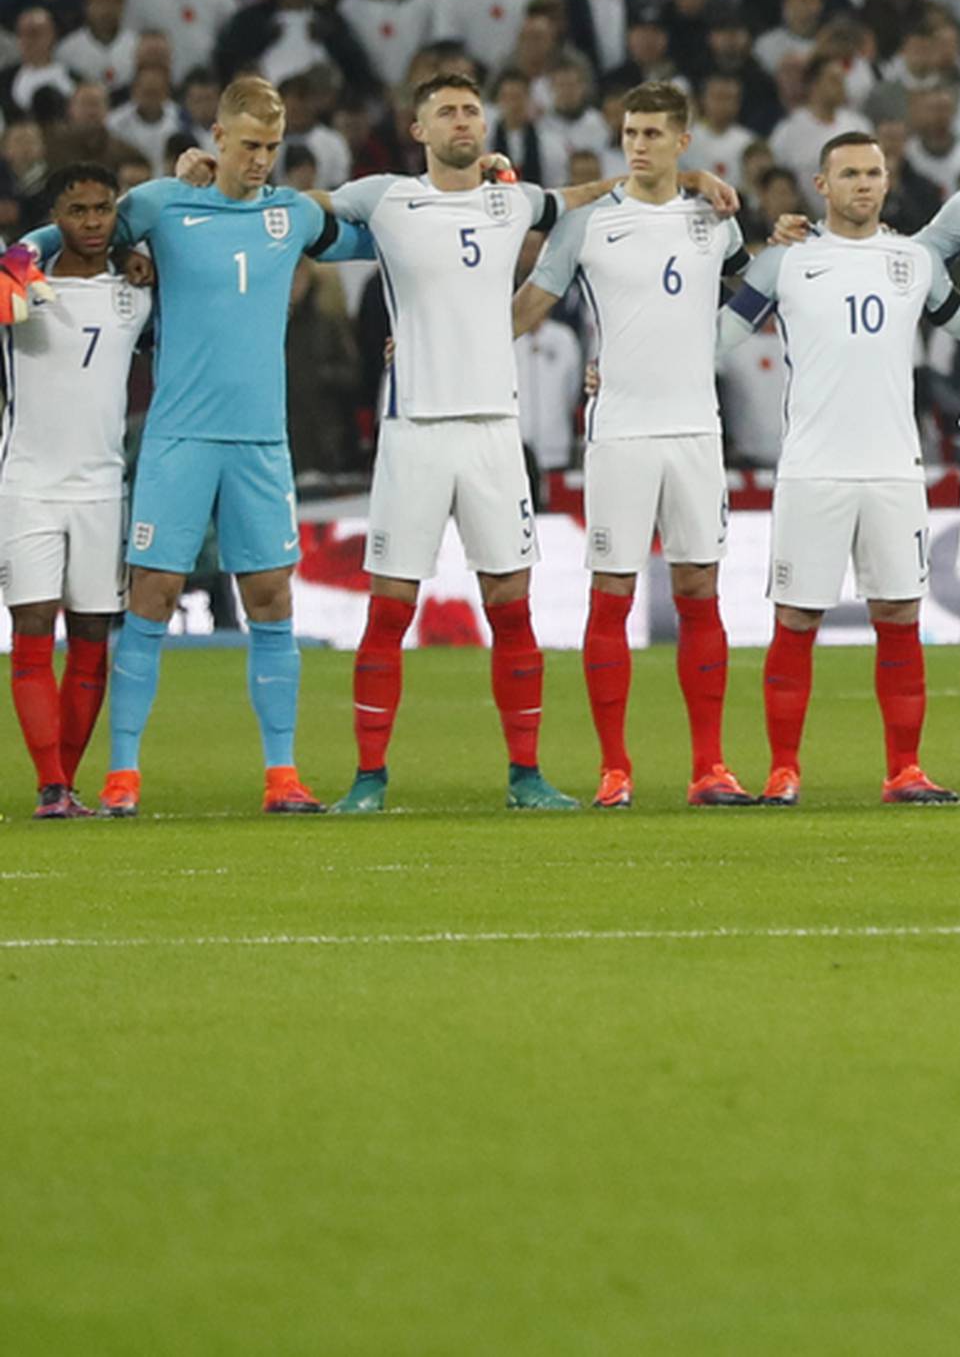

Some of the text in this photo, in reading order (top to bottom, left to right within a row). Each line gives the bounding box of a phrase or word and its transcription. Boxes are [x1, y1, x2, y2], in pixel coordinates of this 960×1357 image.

[459, 227, 482, 268] 5
[233, 251, 248, 294] 1
[662, 255, 683, 296] 6
[845, 294, 885, 335] 10
[82, 327, 101, 369] 7
